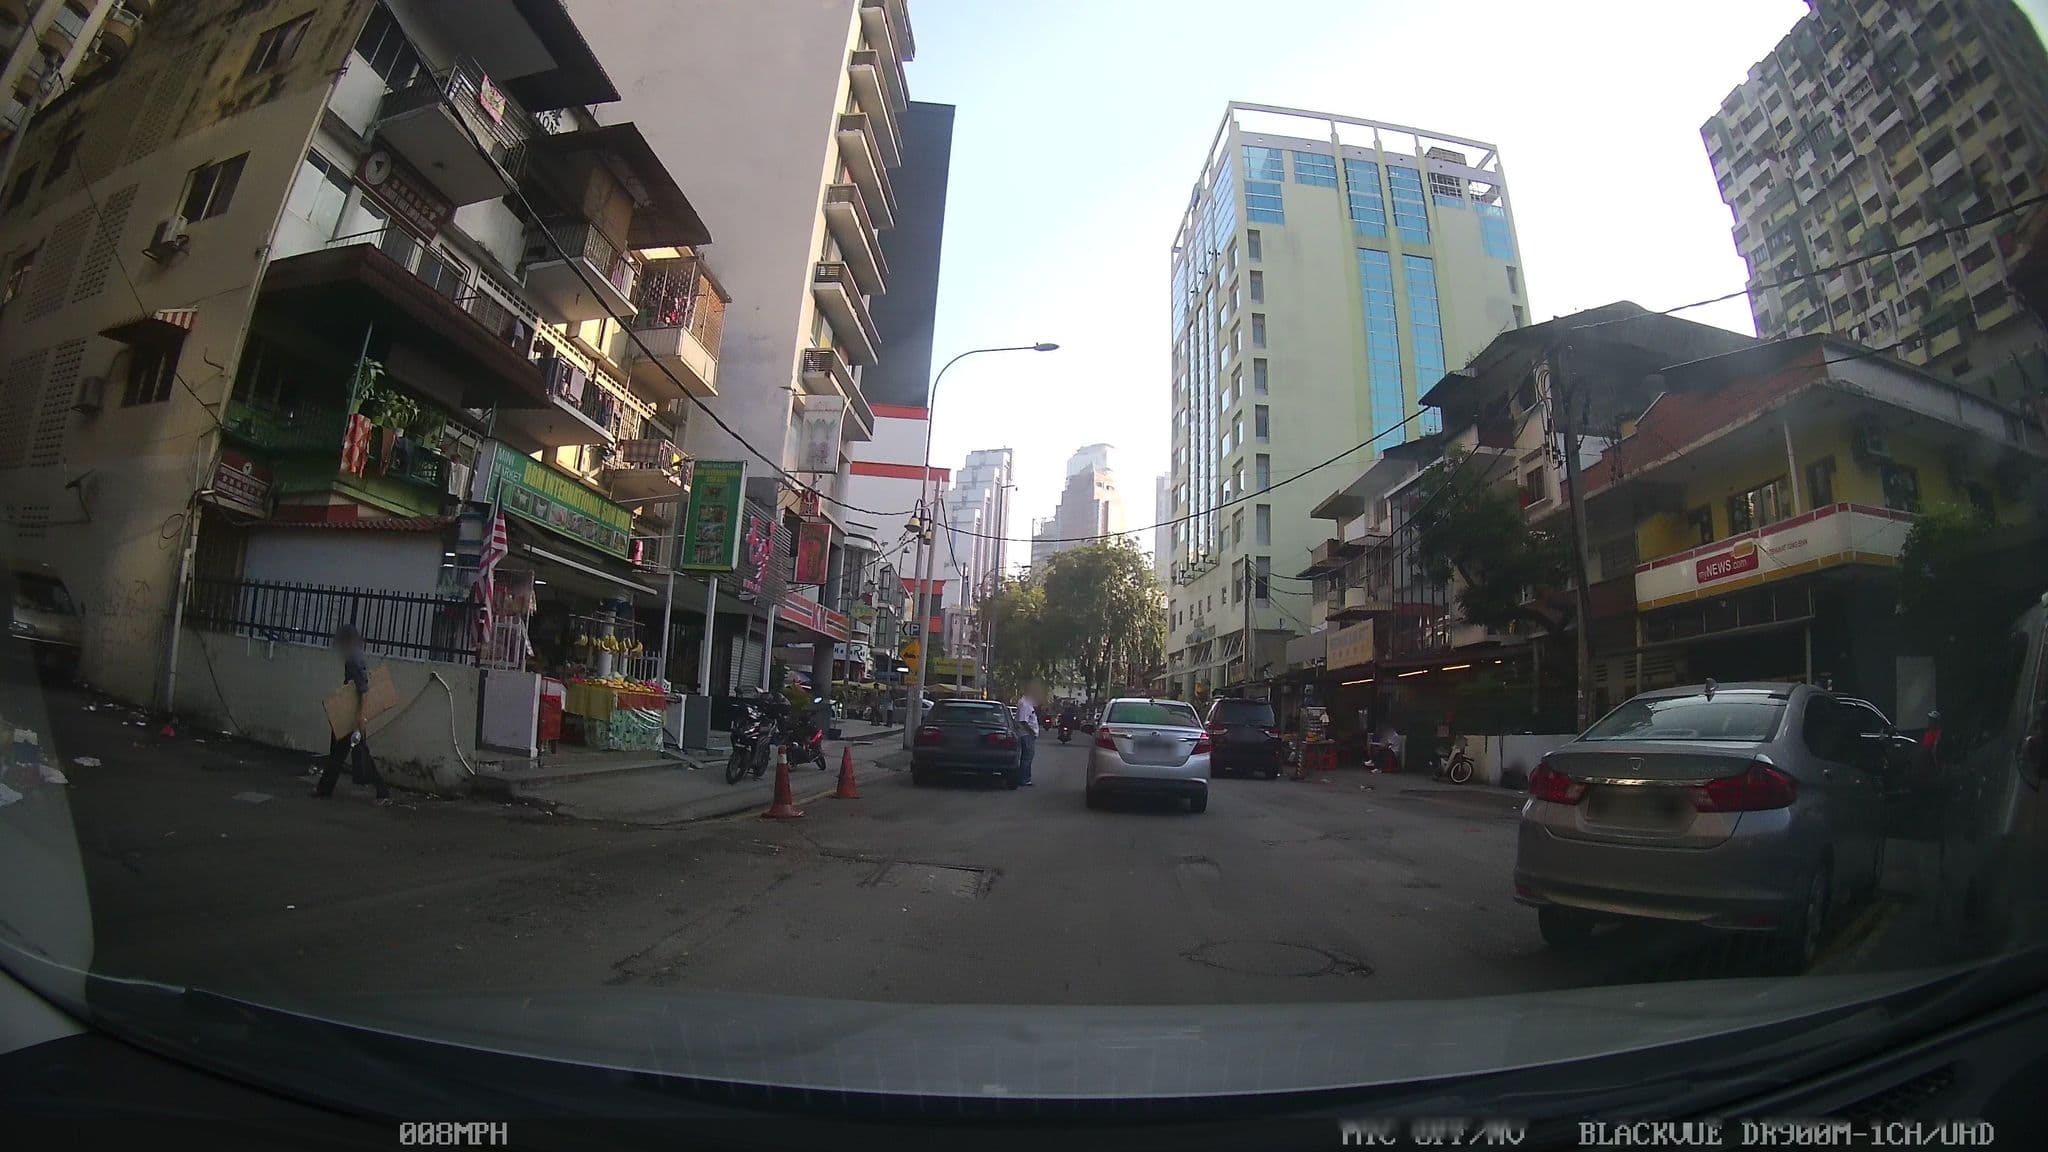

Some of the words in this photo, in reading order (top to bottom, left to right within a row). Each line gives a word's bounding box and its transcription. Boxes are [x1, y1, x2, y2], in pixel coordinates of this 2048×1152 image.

[496, 446, 515, 468] MINI
[494, 462, 522, 482] MARKET
[544, 472, 602, 519] INTERNATIONAL
[911, 624, 920, 635] P
